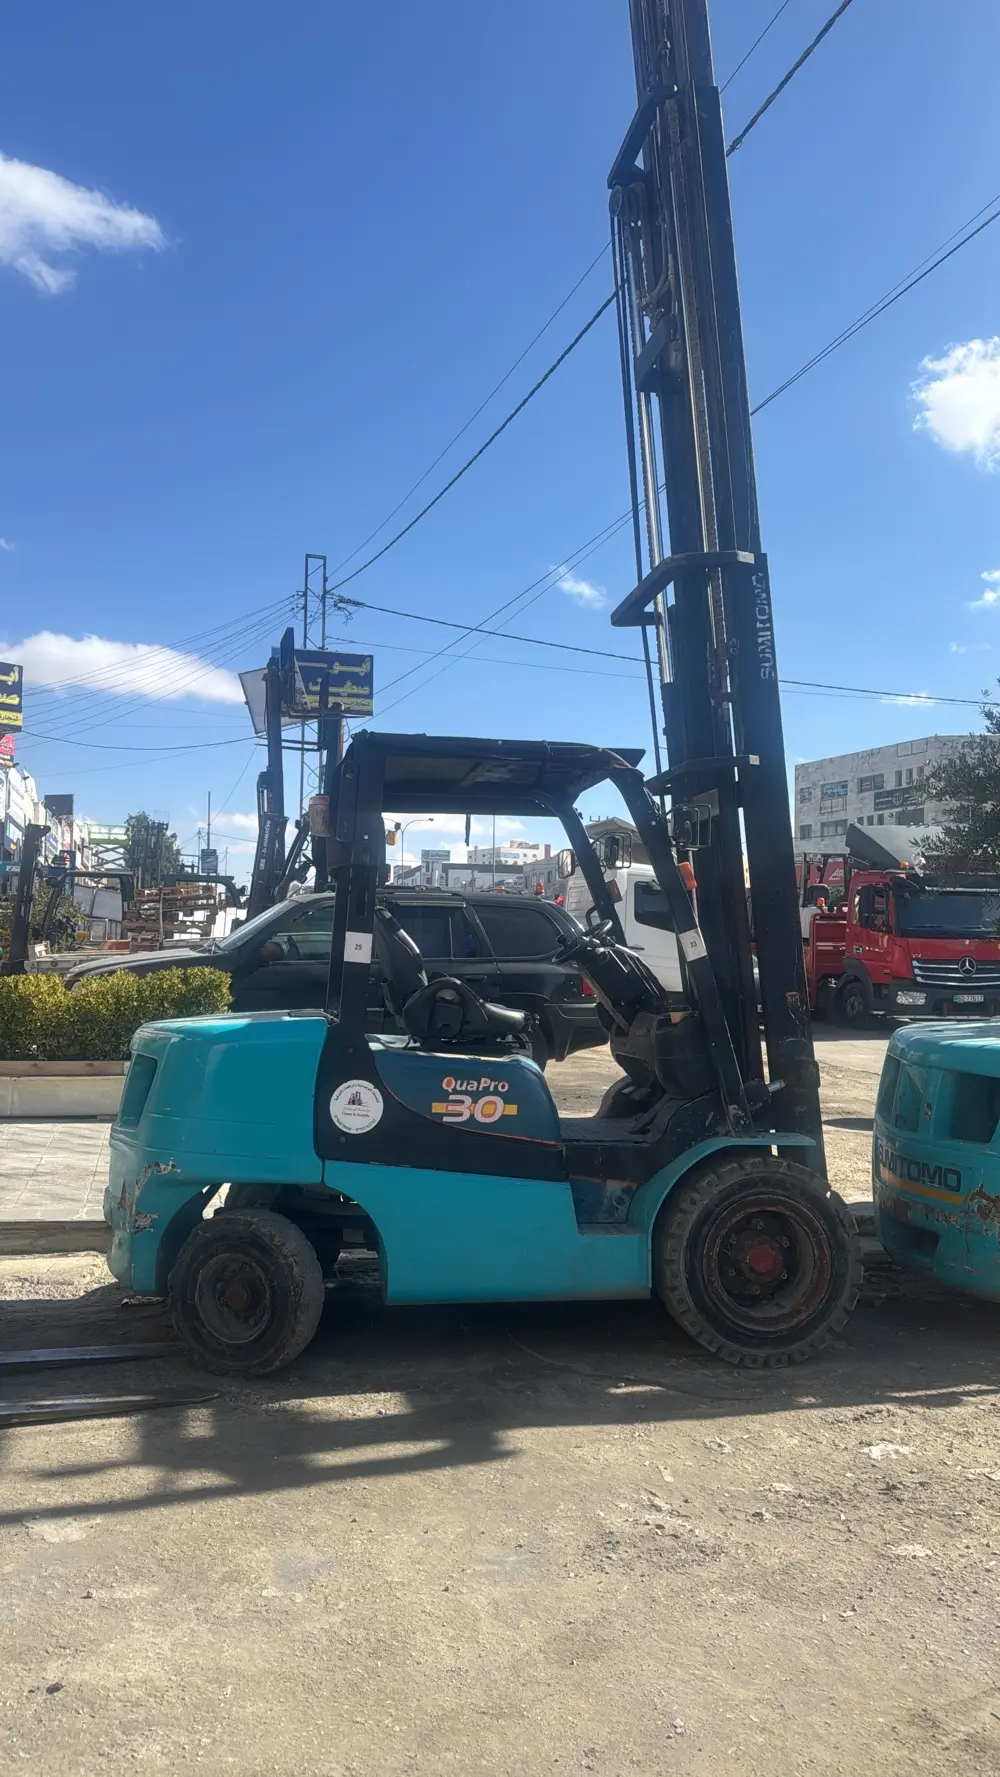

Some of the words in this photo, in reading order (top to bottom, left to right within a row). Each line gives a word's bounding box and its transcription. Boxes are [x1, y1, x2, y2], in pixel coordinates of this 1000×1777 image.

[752, 572, 775, 680] SUMITOMO
[442, 1094, 505, 1123] 30
[879, 1144, 962, 1192] SUMITOMO
